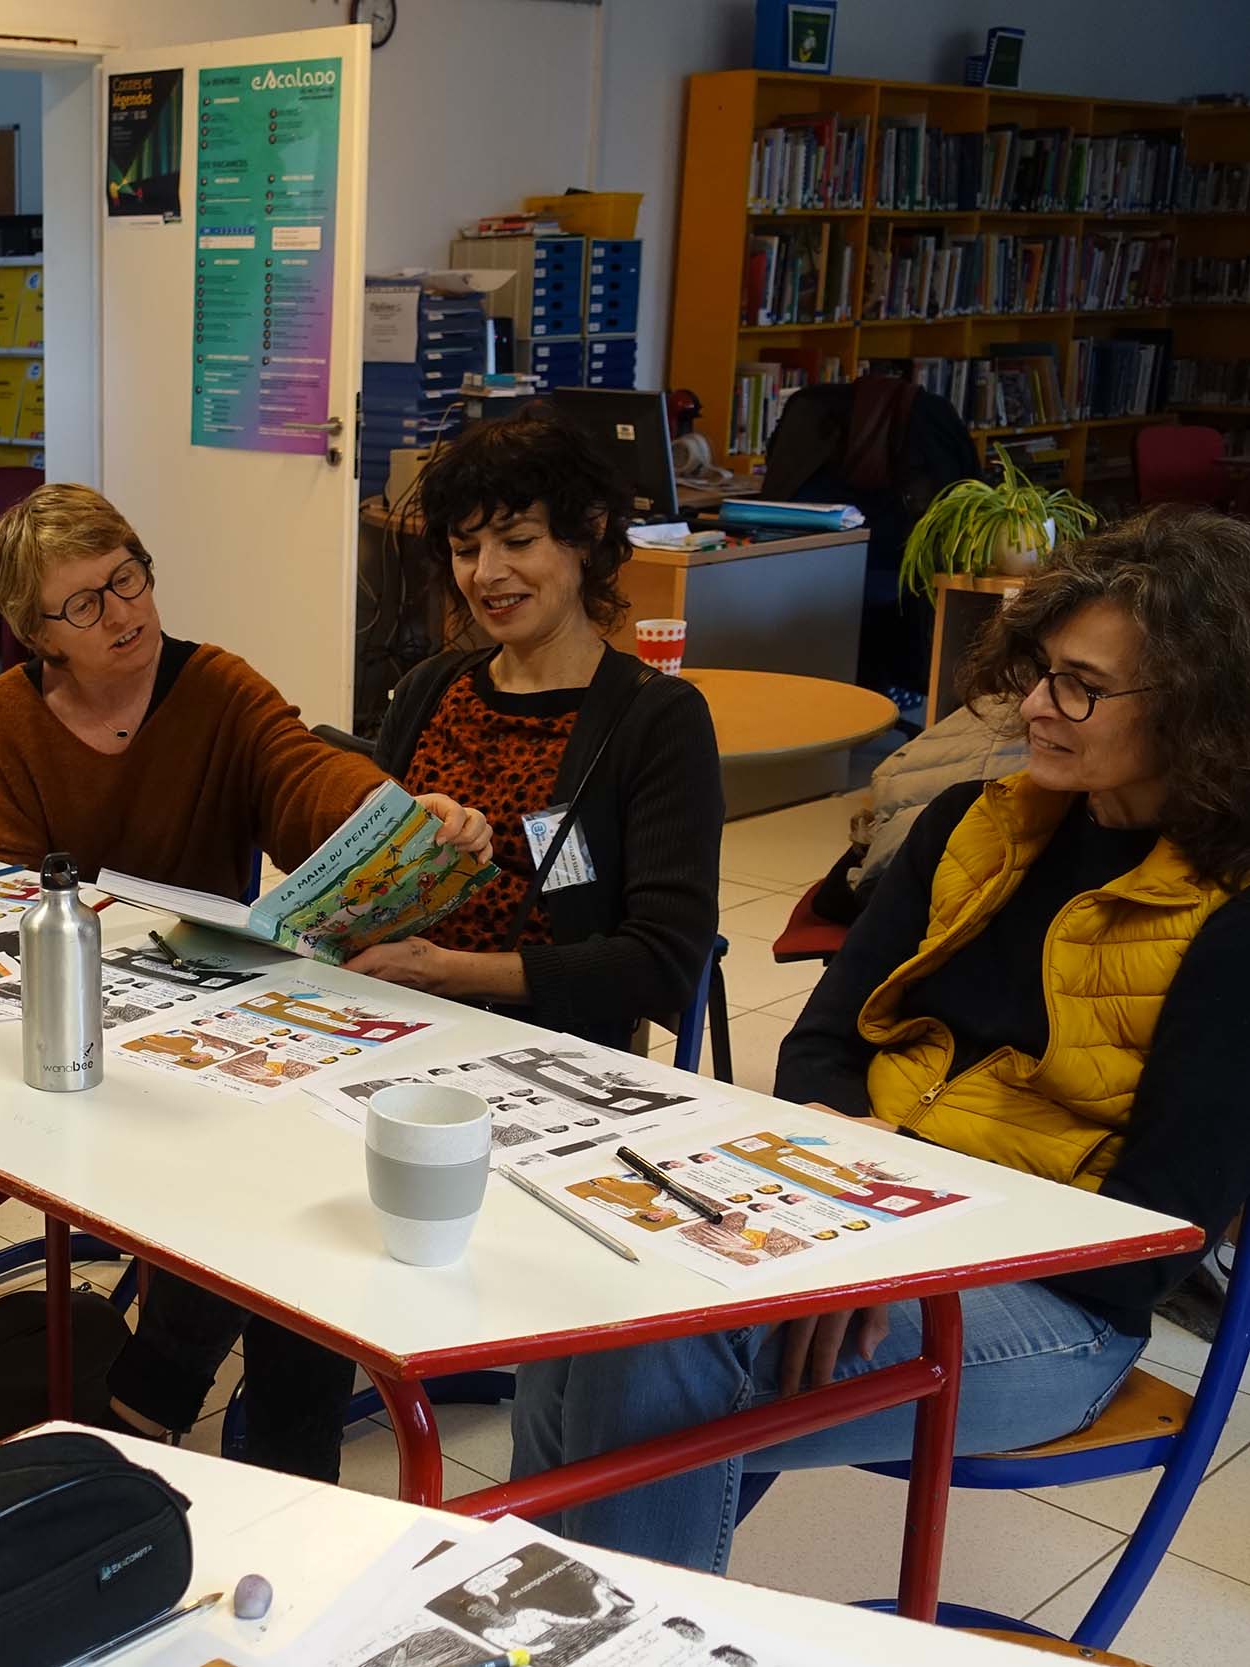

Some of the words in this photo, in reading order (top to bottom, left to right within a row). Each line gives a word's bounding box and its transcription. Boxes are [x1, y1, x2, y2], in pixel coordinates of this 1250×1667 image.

[280, 889, 295, 902] LA
[297, 862, 327, 890] MAIN
[329, 848, 343, 863] DU
[344, 803, 390, 849] PEINTRE
[43, 1060, 94, 1073] wanabee
